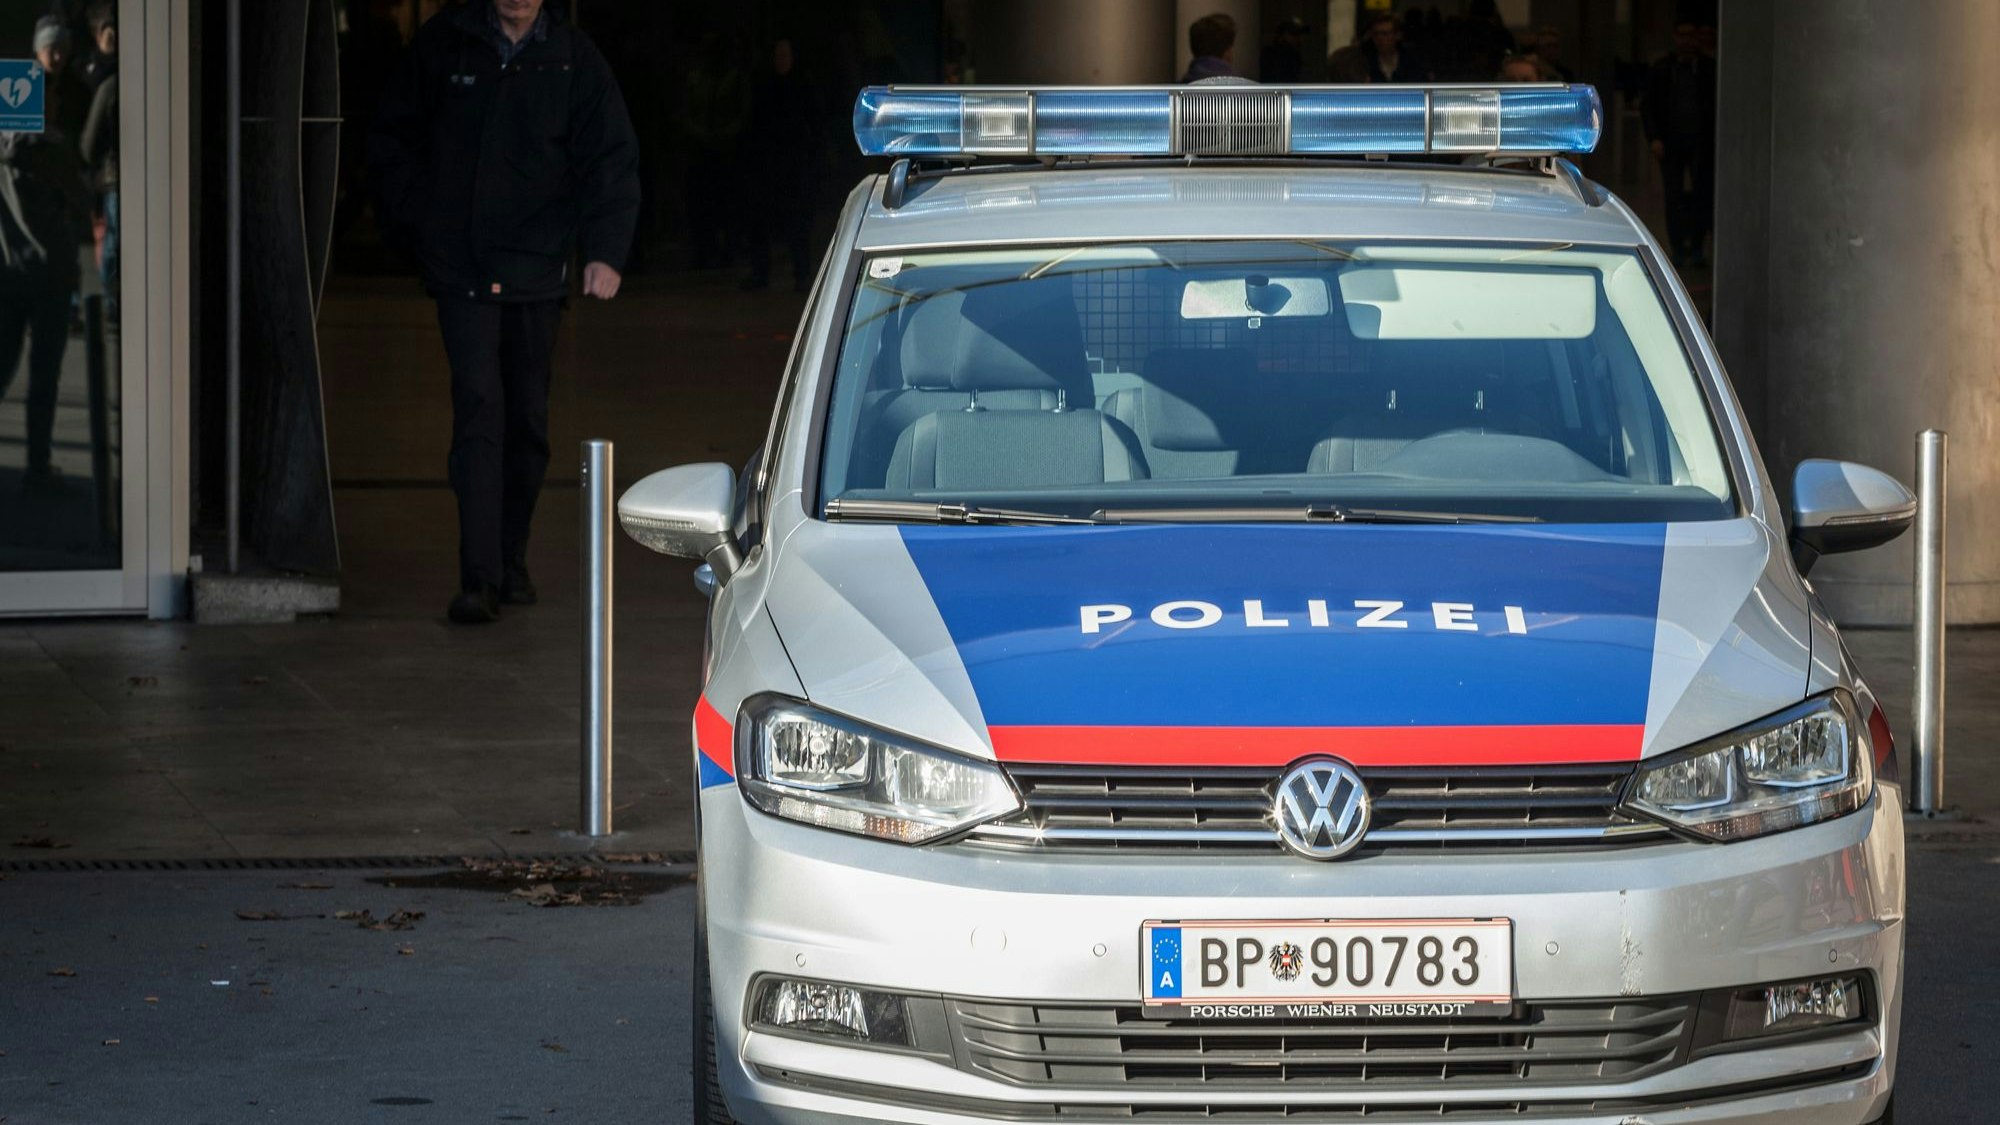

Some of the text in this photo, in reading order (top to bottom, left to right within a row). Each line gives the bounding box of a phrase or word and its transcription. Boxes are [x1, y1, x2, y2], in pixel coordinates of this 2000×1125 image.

[1080, 599, 1528, 634] POLIZEI
[1276, 761, 1369, 858] VW
[1159, 971, 1175, 988] A
[1200, 936, 1480, 988] BP 90783
[1190, 1003, 1466, 1018] PORSCHE WIENER NEUSTADT
